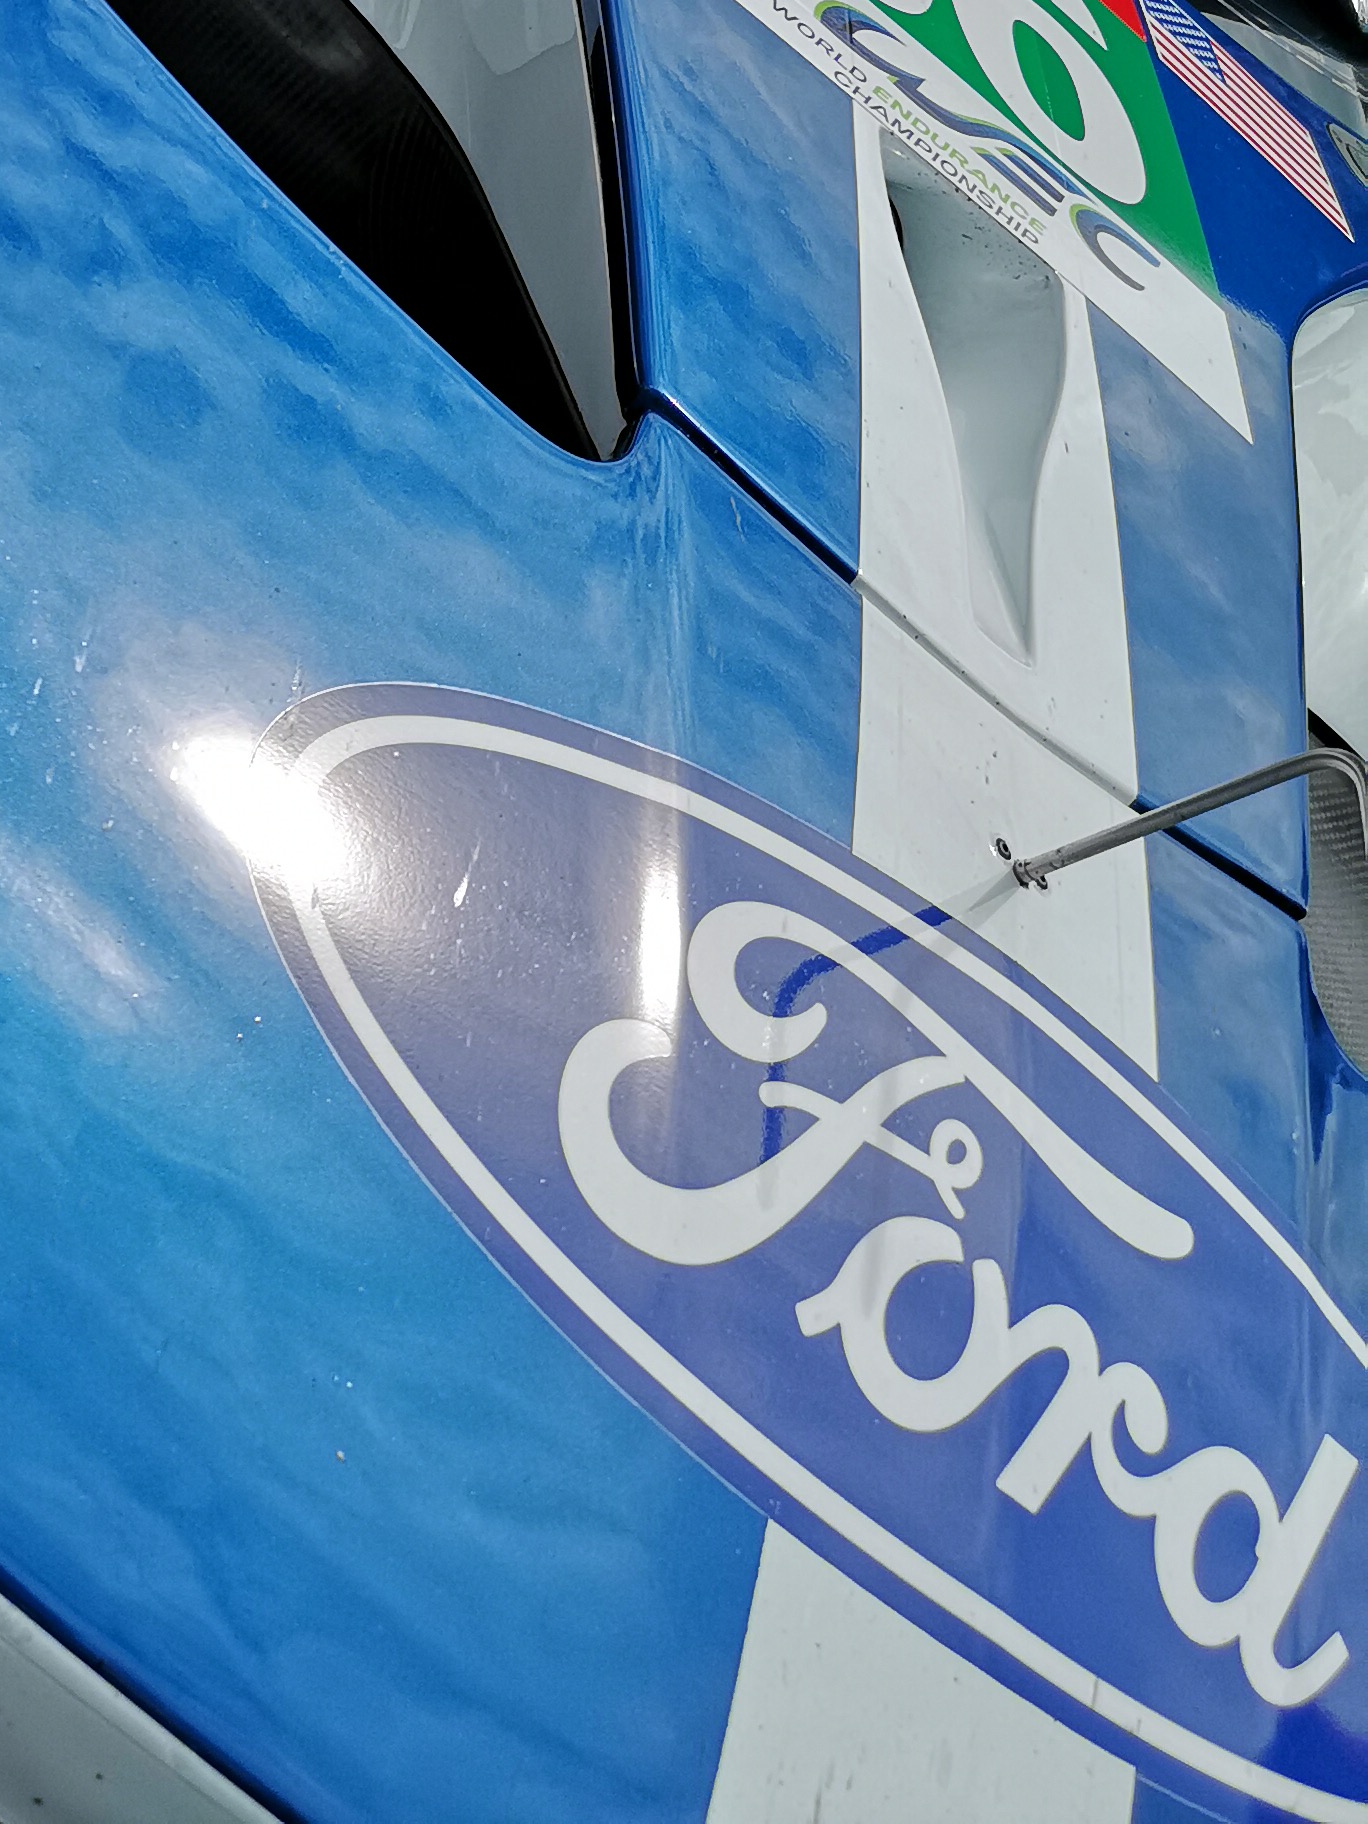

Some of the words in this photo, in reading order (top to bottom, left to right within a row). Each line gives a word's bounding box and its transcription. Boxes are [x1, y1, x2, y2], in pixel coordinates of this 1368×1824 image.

[834, 70, 1040, 245] CHAMPIONSHIP
[872, 85, 1047, 236] ENDURANCE
[558, 900, 1359, 1707] Ford
